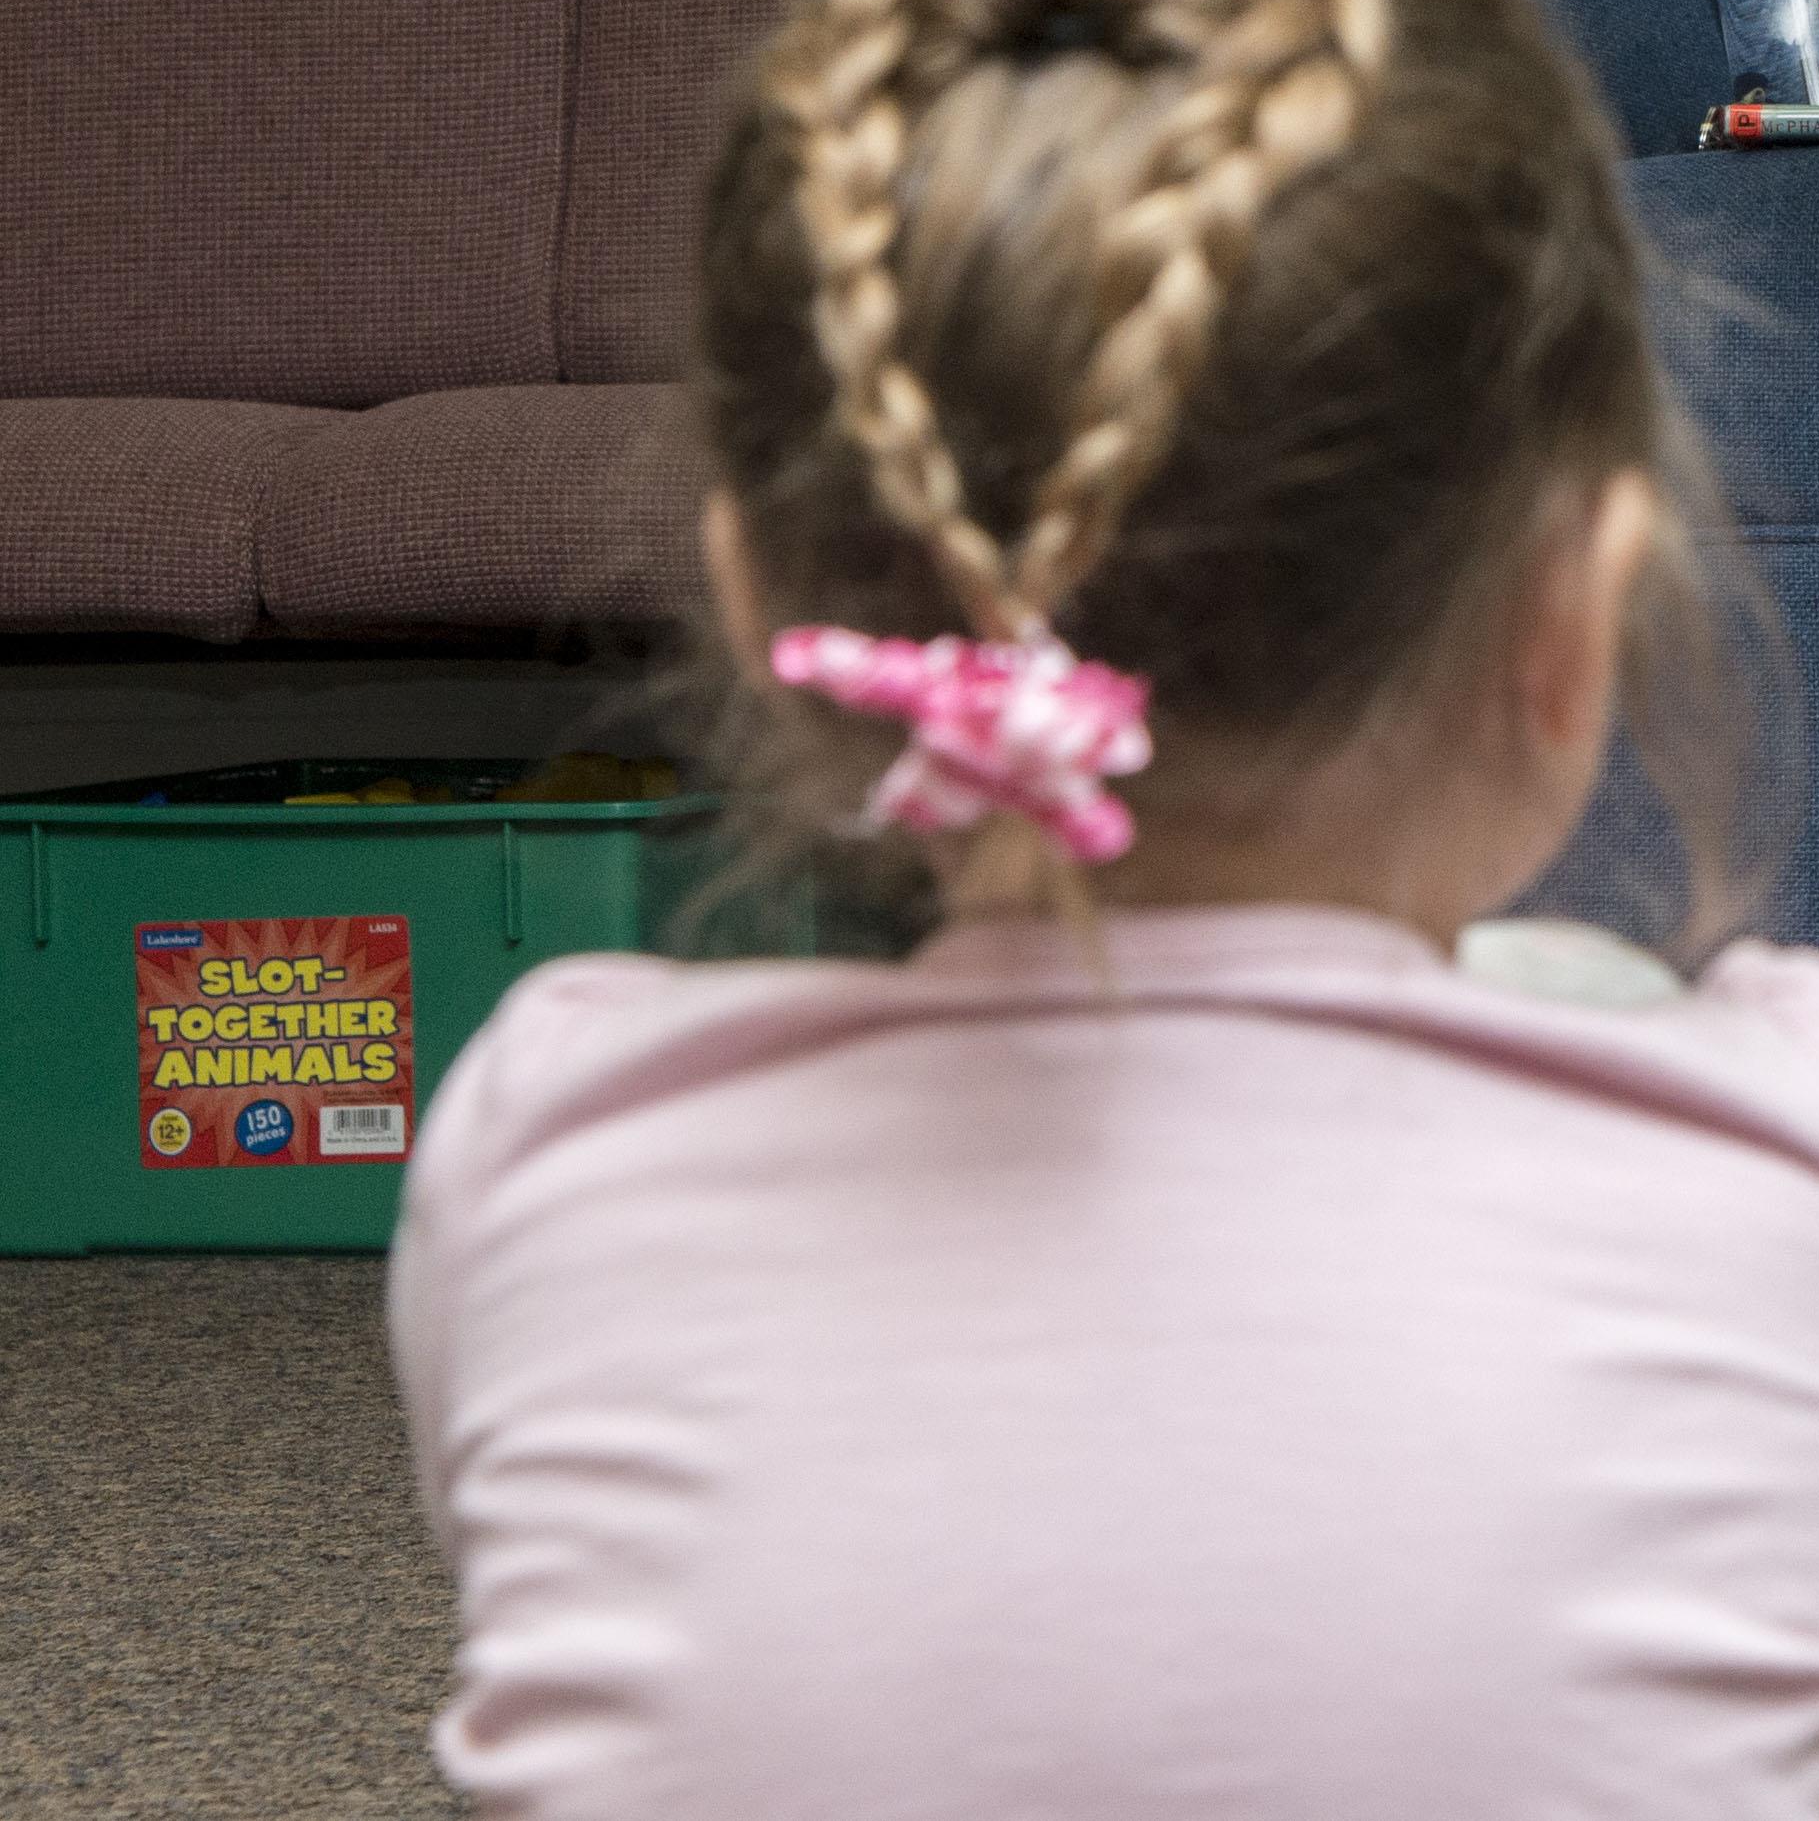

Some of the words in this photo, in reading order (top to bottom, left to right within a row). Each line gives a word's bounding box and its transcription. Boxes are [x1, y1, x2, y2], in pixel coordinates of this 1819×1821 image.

[199, 956, 346, 997] SLOT-
[147, 999, 398, 1043] TOGETHER
[152, 1042, 398, 1089] ANIMALS
[158, 1123, 184, 1140] 12+
[246, 1105, 282, 1132] 150
[245, 1126, 288, 1148] pieces
